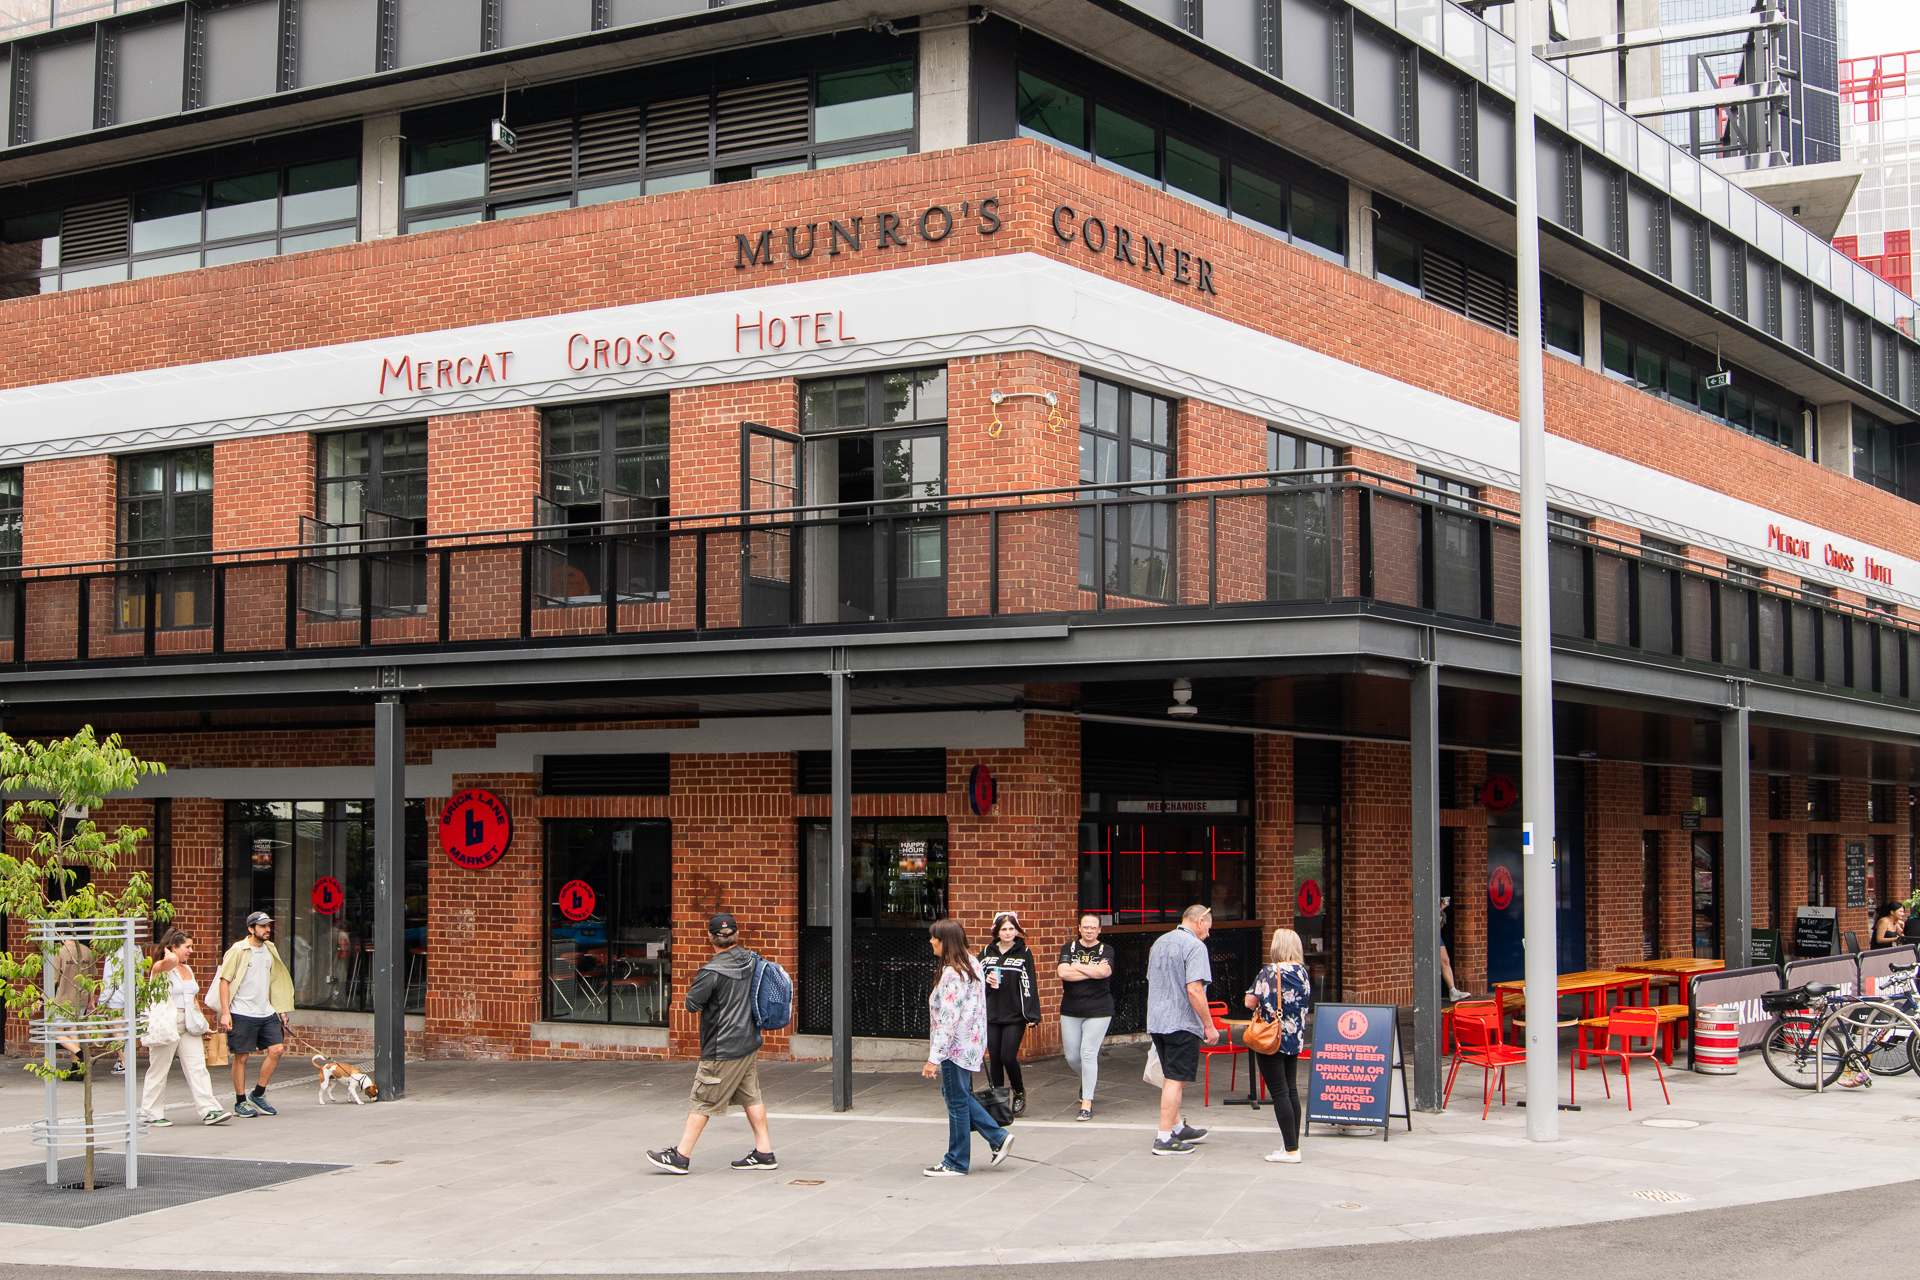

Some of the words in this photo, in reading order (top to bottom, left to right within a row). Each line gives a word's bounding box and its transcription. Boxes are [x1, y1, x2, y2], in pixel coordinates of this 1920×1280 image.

[734, 197, 1001, 269] MUNRO'S
[1052, 205, 1218, 295] CORNER
[379, 351, 514, 394] MERCAT
[567, 331, 675, 371] CROSS
[736, 310, 856, 353] HOTEL
[1768, 524, 1811, 559] MERCAT
[1824, 543, 1854, 572] CROSS
[1865, 556, 1893, 585] HOTEL
[443, 792, 474, 825] BRICK
[478, 793, 505, 825] LANE
[449, 844, 498, 865] MARKET
[561, 882, 577, 898] BRICK
[579, 883, 593, 899] LANE
[316, 903, 338, 913] MARKET
[564, 908, 590, 919] MARKET
[1340, 1012, 1354, 1023] BRICK
[1356, 1012, 1366, 1024] LANE
[1324, 1044, 1378, 1053] BREWERY
[1316, 1051, 1352, 1060] FRESH
[1355, 1053, 1385, 1061] BEER
[1315, 1064, 1350, 1073] DRINK
[1352, 1065, 1365, 1074] IN
[1367, 1066, 1384, 1075] OR
[1320, 1072, 1378, 1082] TAKEAWAY
[1325, 1085, 1371, 1095] MARKET
[1320, 1093, 1375, 1103] SOURCED
[1333, 1102, 1361, 1111] EATS
